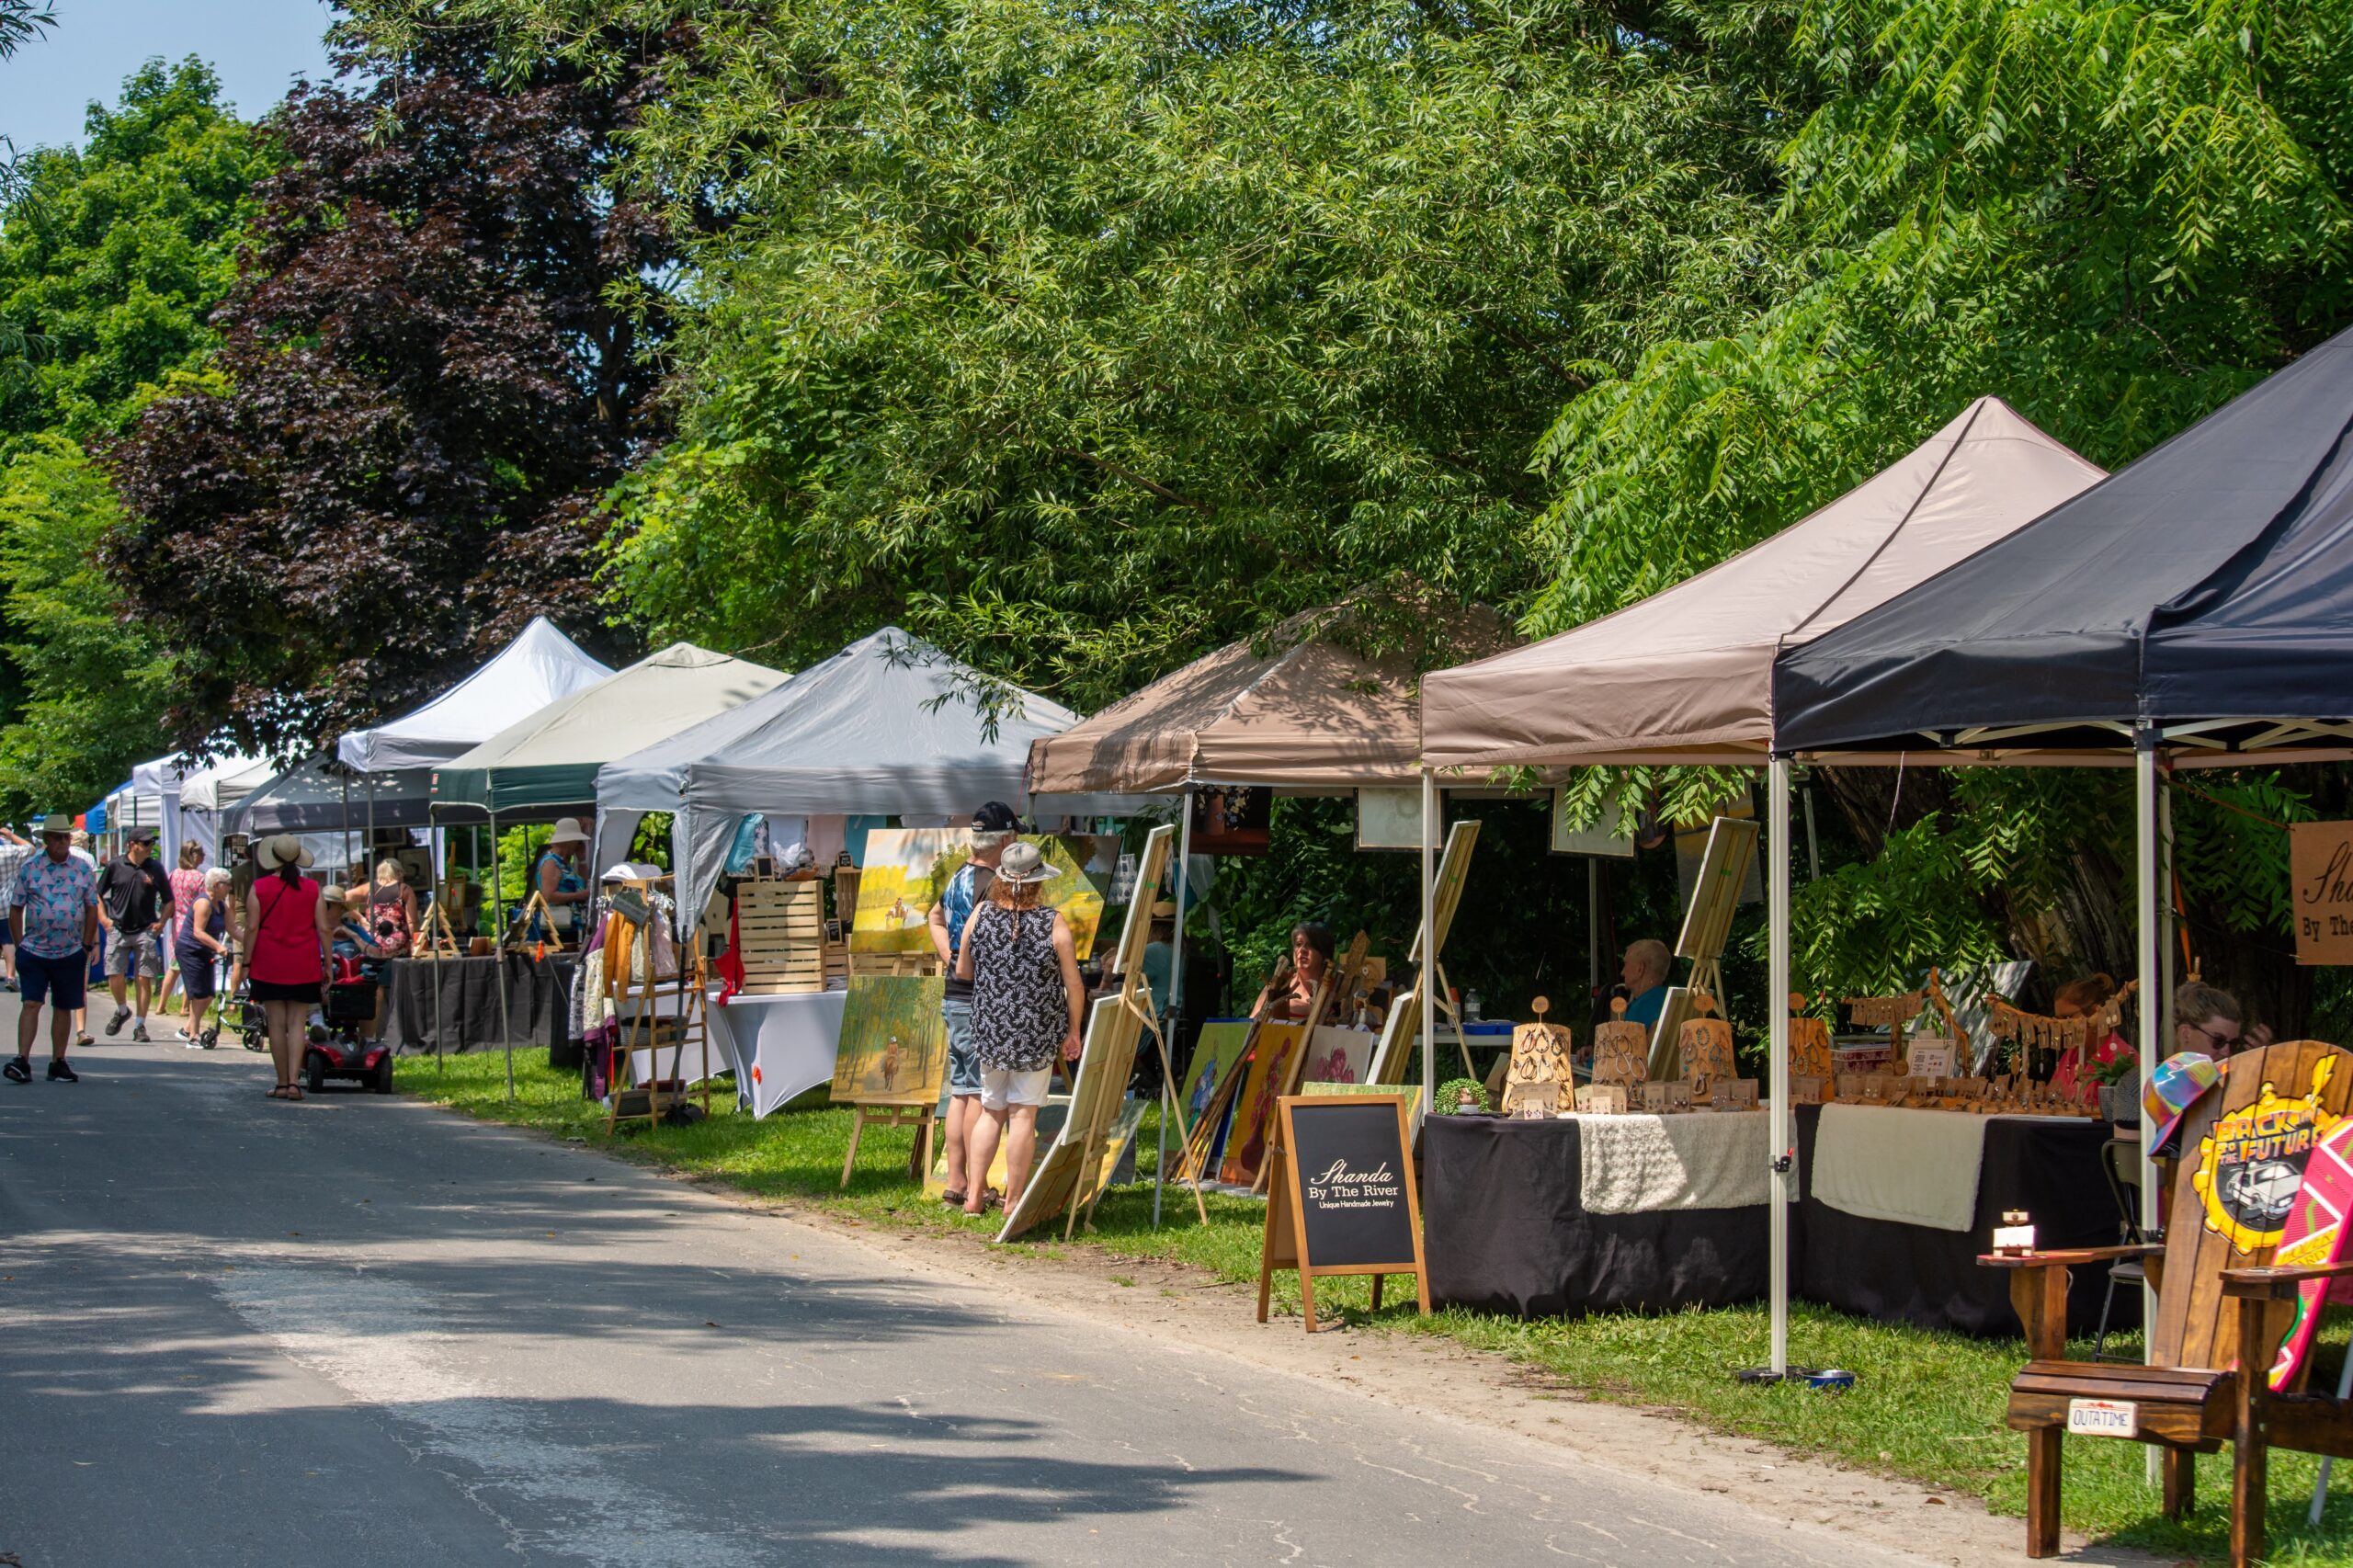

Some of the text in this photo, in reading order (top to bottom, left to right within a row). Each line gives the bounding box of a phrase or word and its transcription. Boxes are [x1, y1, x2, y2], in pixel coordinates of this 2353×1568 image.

[2302, 916, 2320, 942] By
[2213, 1111, 2301, 1142] BACK
[2218, 1153, 2238, 1165] THE
[1310, 1158, 1393, 1185] Shanda
[1308, 1185, 1398, 1200] By The River
[1319, 1199, 1394, 1210] Unique Handmade Jewelry
[2073, 1409, 2129, 1426] OUTATIME
